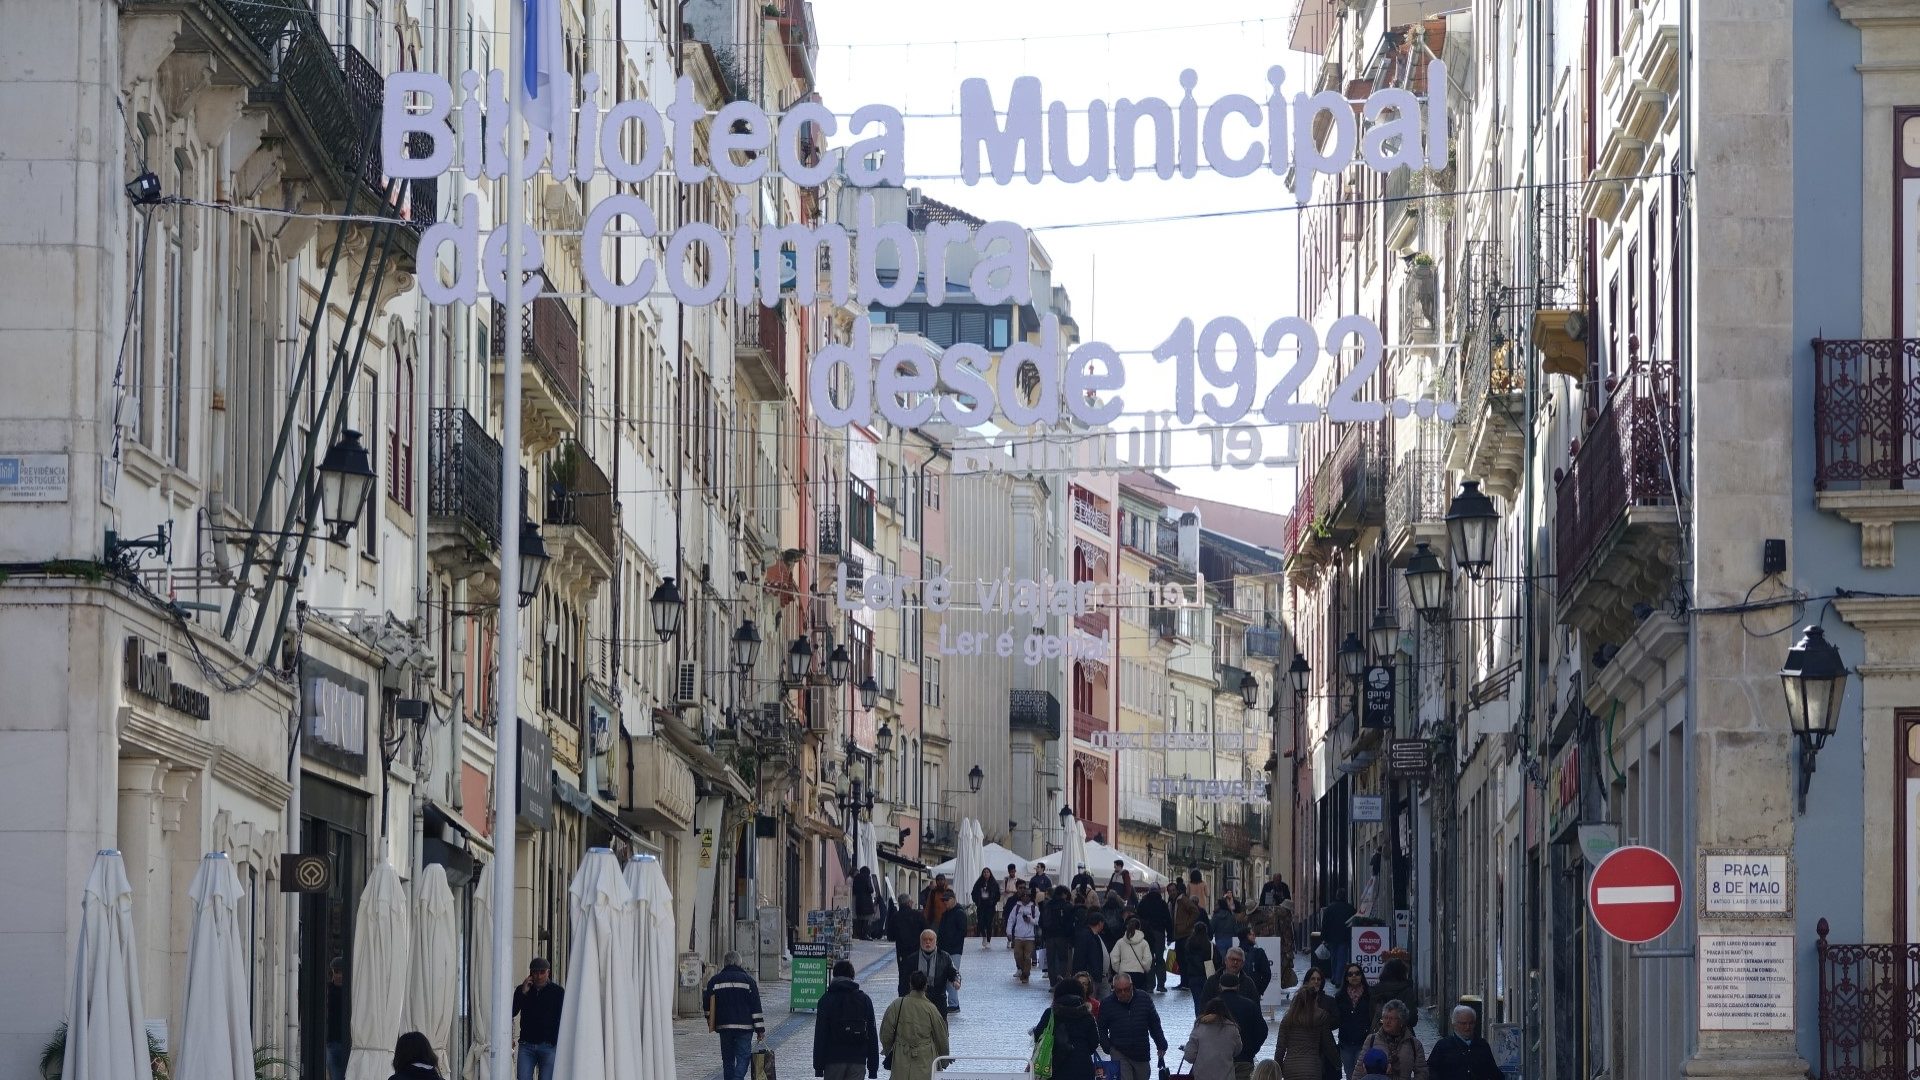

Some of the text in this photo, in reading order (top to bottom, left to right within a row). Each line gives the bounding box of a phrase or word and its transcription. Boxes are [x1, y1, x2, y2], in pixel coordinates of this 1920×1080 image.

[382, 58, 1448, 203] Biblioteca Municipal
[416, 193, 1032, 308] de Coimbra
[809, 312, 1459, 428] desde 1922...
[20, 466, 66, 476] PREVIDÊNCIA
[20, 476, 66, 484] PORTUGUESA
[836, 562, 914, 611] Ler
[923, 564, 953, 613] é
[975, 566, 1096, 628] viajar
[938, 622, 1110, 666] Ler é genial
[1367, 690, 1391, 699] gang
[1369, 701, 1388, 710] four
[1724, 864, 1769, 877] PRAÇA
[1713, 882, 1780, 893] 8 DE MAIO
